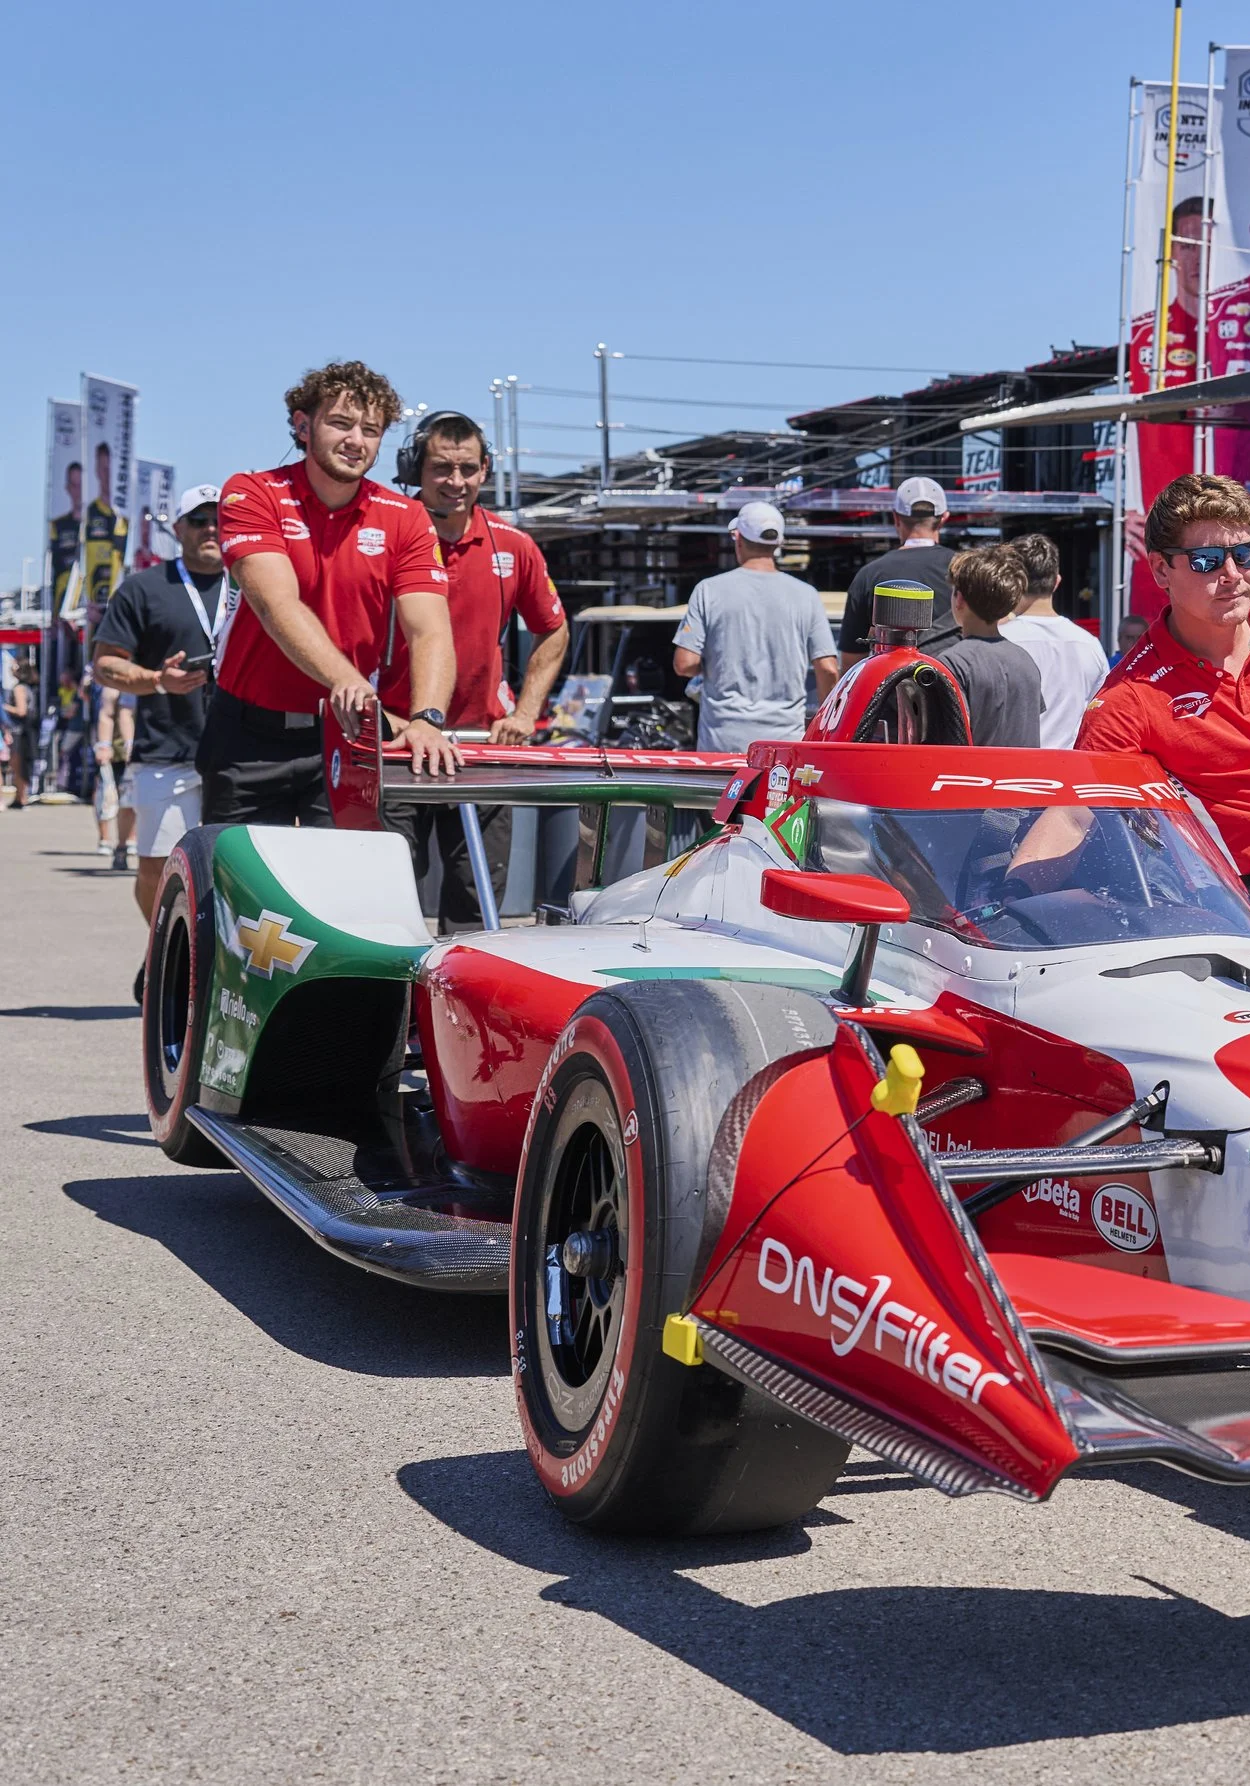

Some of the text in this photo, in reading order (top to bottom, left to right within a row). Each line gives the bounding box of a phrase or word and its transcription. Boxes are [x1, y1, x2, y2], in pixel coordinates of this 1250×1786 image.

[1181, 114, 1207, 127] NTT
[966, 450, 1000, 475] TEA
[1039, 1178, 1081, 1214] Beta
[1101, 1195, 1148, 1236] BELL
[1110, 1227, 1137, 1245] HELMETS
[561, 1365, 626, 1488] Firestone
